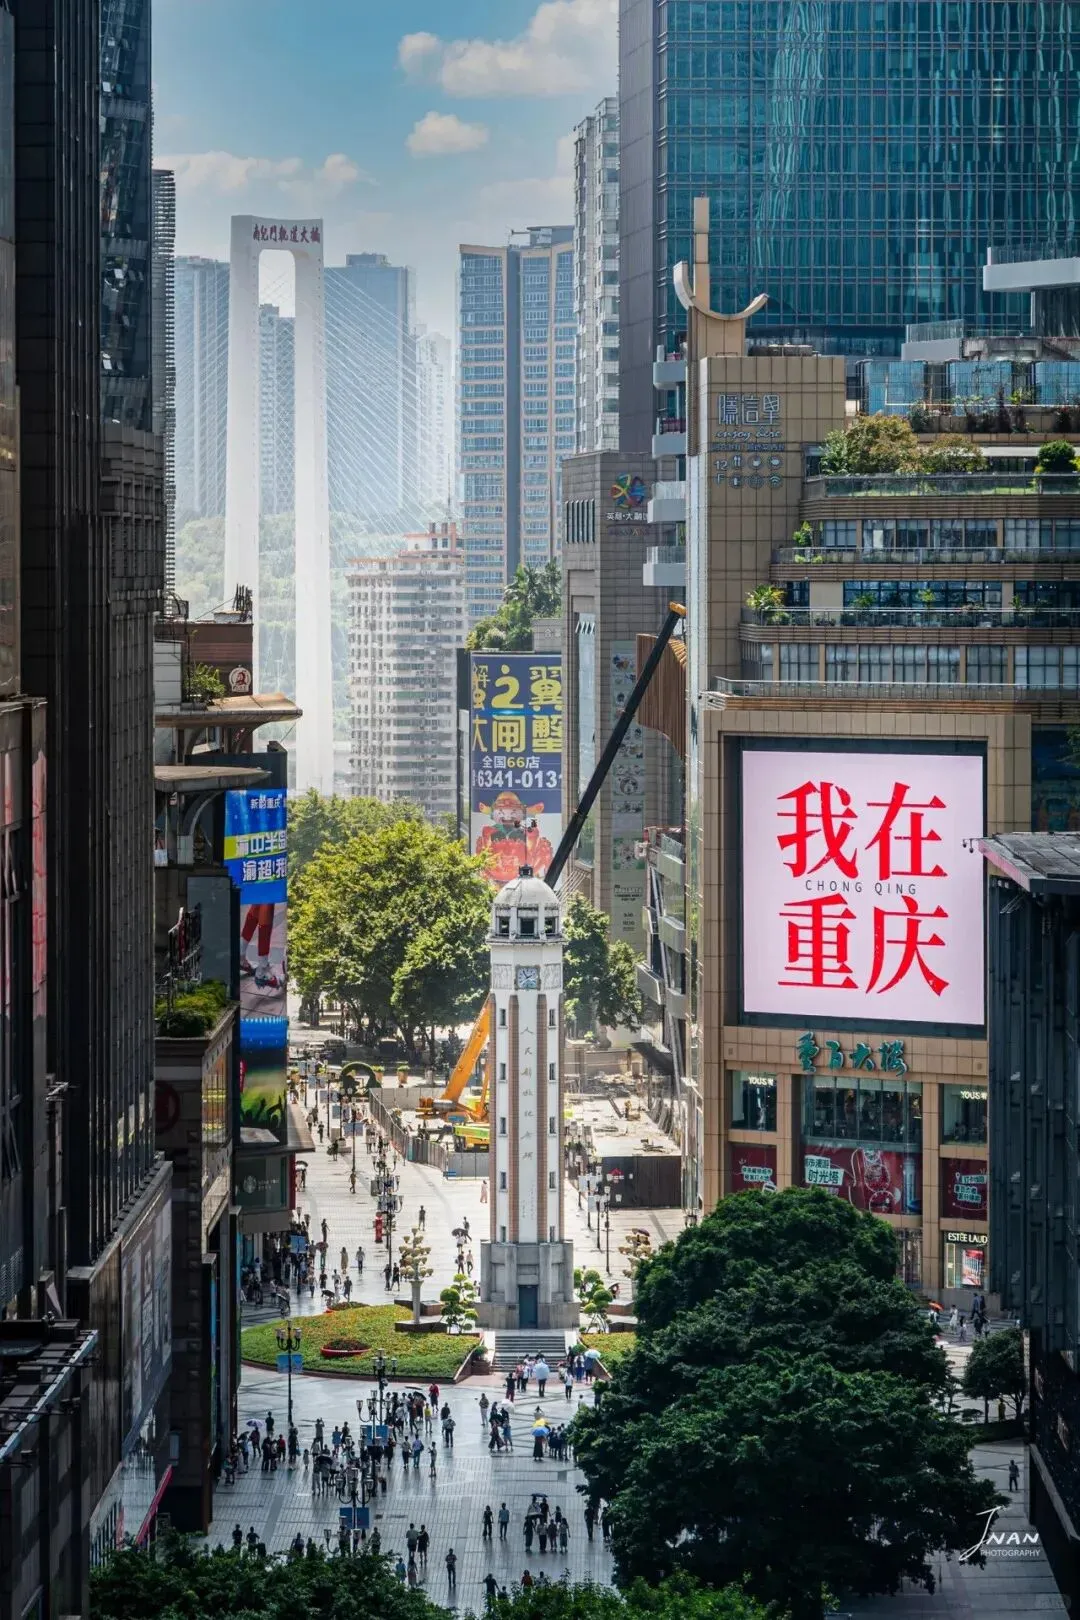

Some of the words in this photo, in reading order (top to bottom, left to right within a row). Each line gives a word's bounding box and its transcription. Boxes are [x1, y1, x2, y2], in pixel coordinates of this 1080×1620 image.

[715, 460, 728, 470] 12
[482, 755, 540, 769] 全国66店
[777, 781, 947, 880] 我在
[805, 880, 862, 893] CHONG
[874, 882, 917, 895] QING
[778, 893, 949, 996] 重庆
